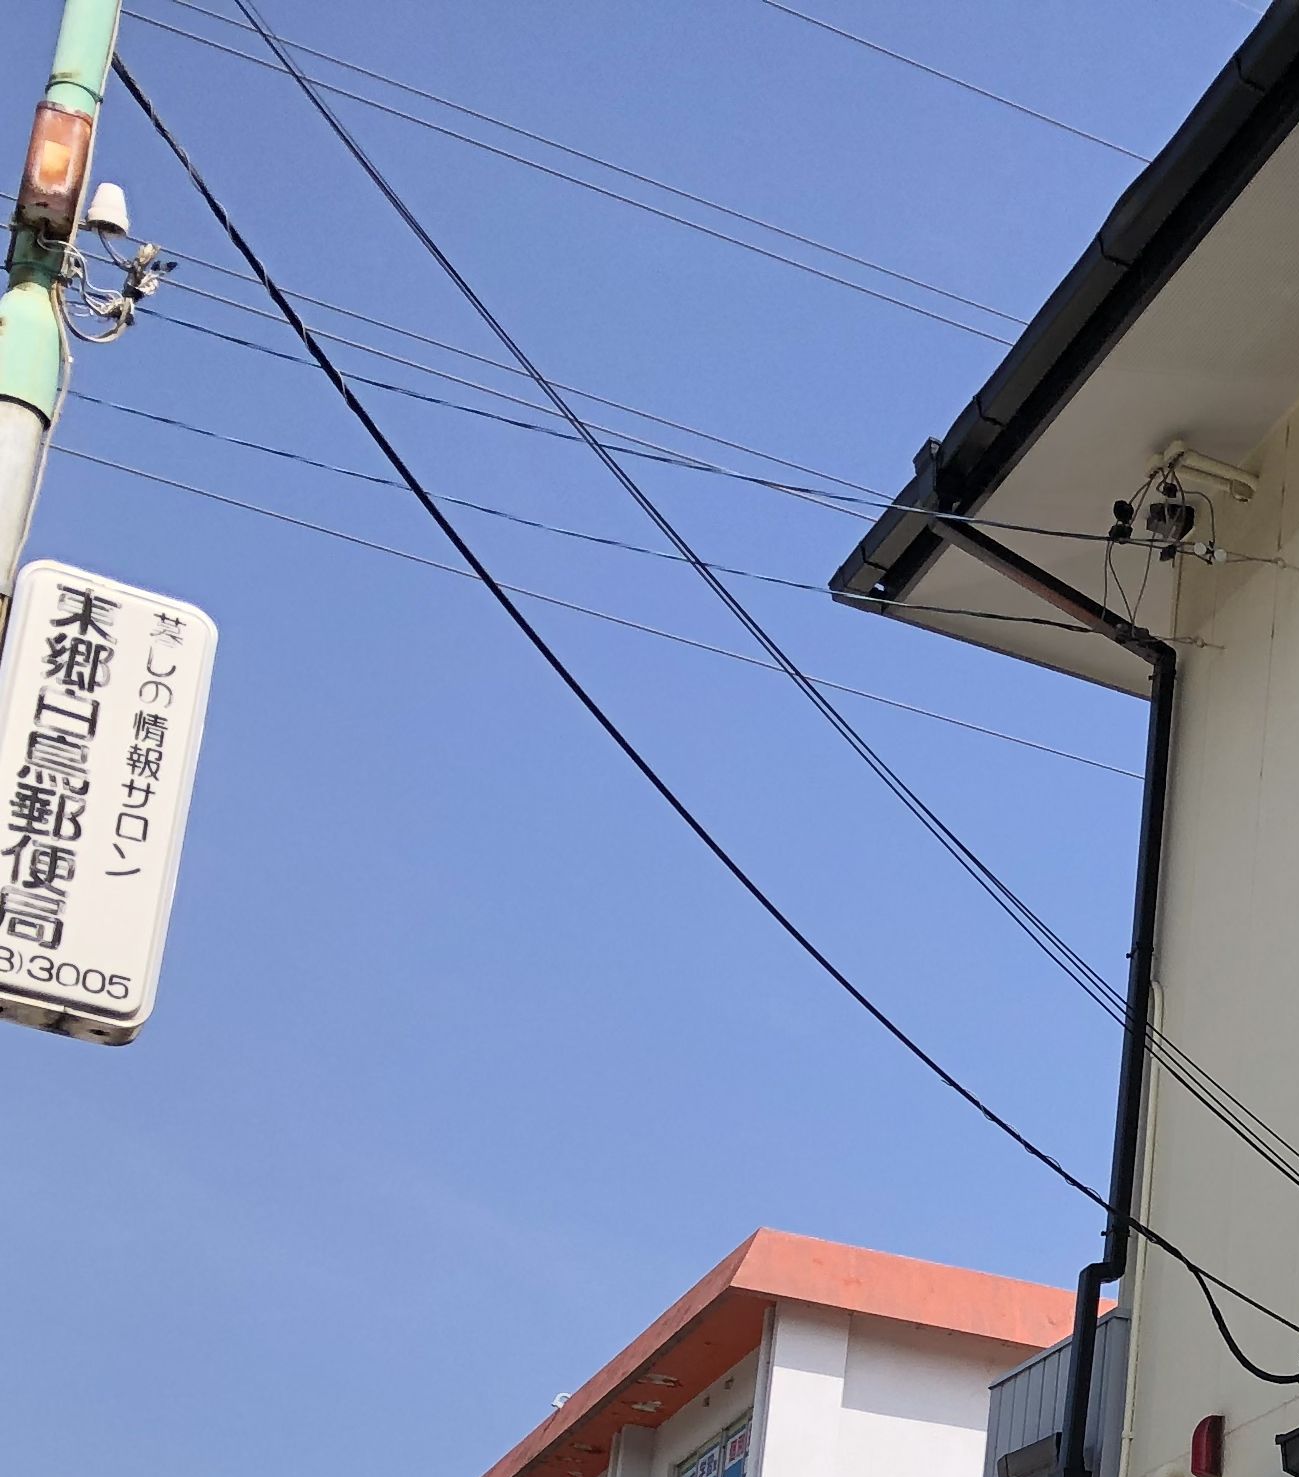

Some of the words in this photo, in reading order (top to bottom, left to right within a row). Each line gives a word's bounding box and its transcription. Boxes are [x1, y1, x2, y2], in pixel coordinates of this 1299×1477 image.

[0, 582, 122, 951] 東郷白鳥郵便局
